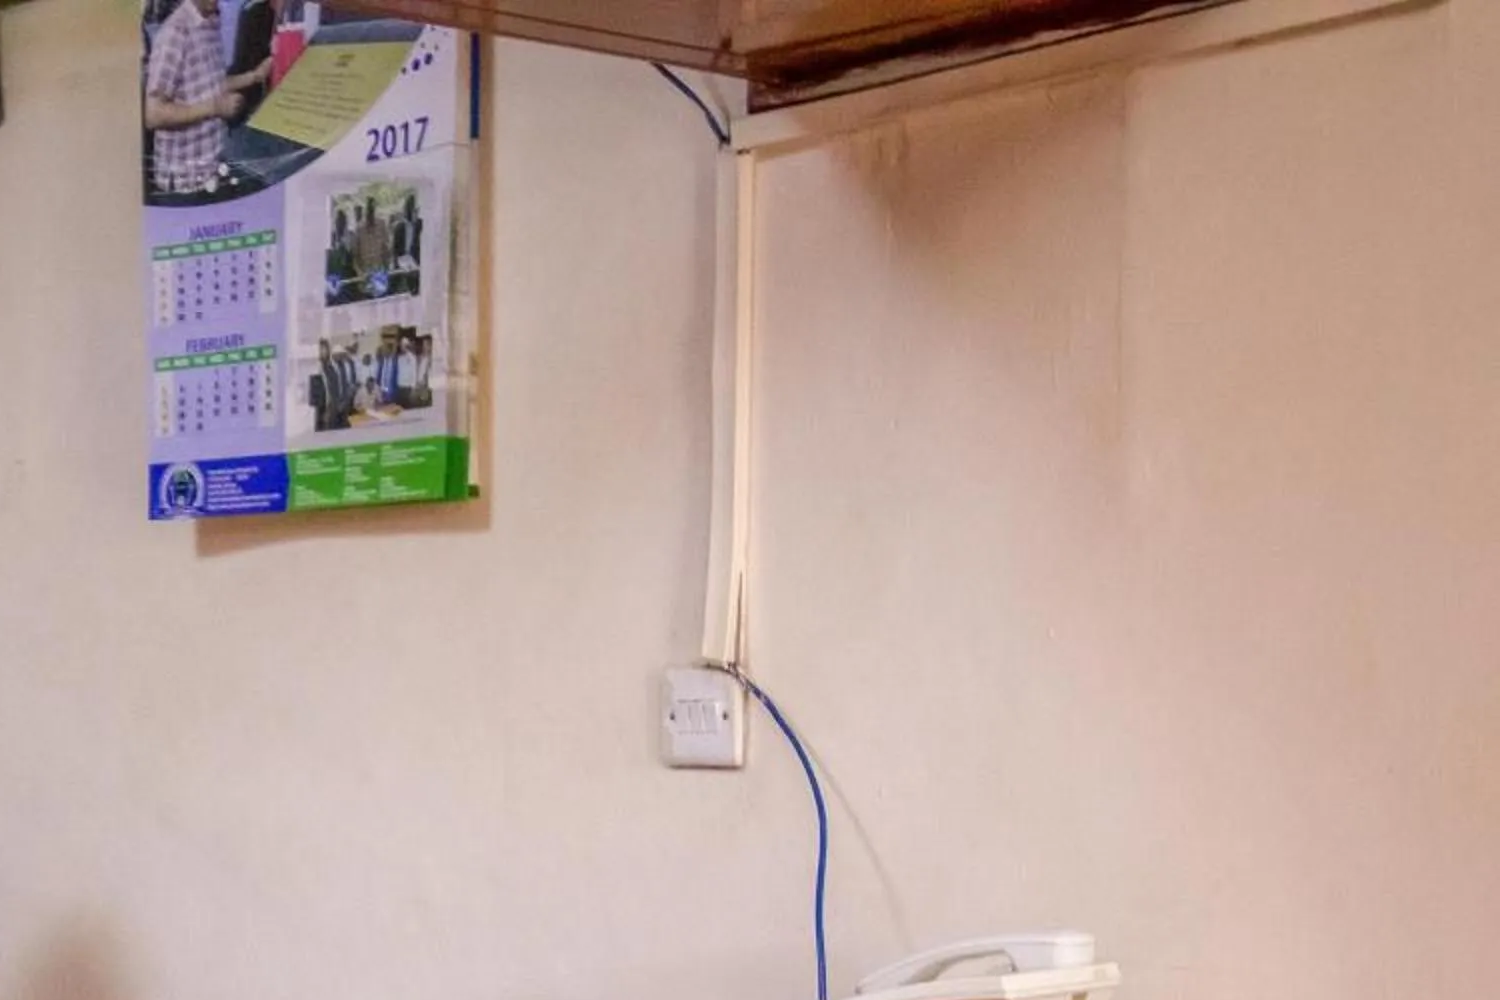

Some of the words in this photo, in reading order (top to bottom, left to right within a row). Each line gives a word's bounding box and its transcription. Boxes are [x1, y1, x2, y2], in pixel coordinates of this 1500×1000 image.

[366, 115, 429, 161] 2017
[189, 221, 244, 240] JANUARY
[186, 334, 244, 353] FEBRUARY
